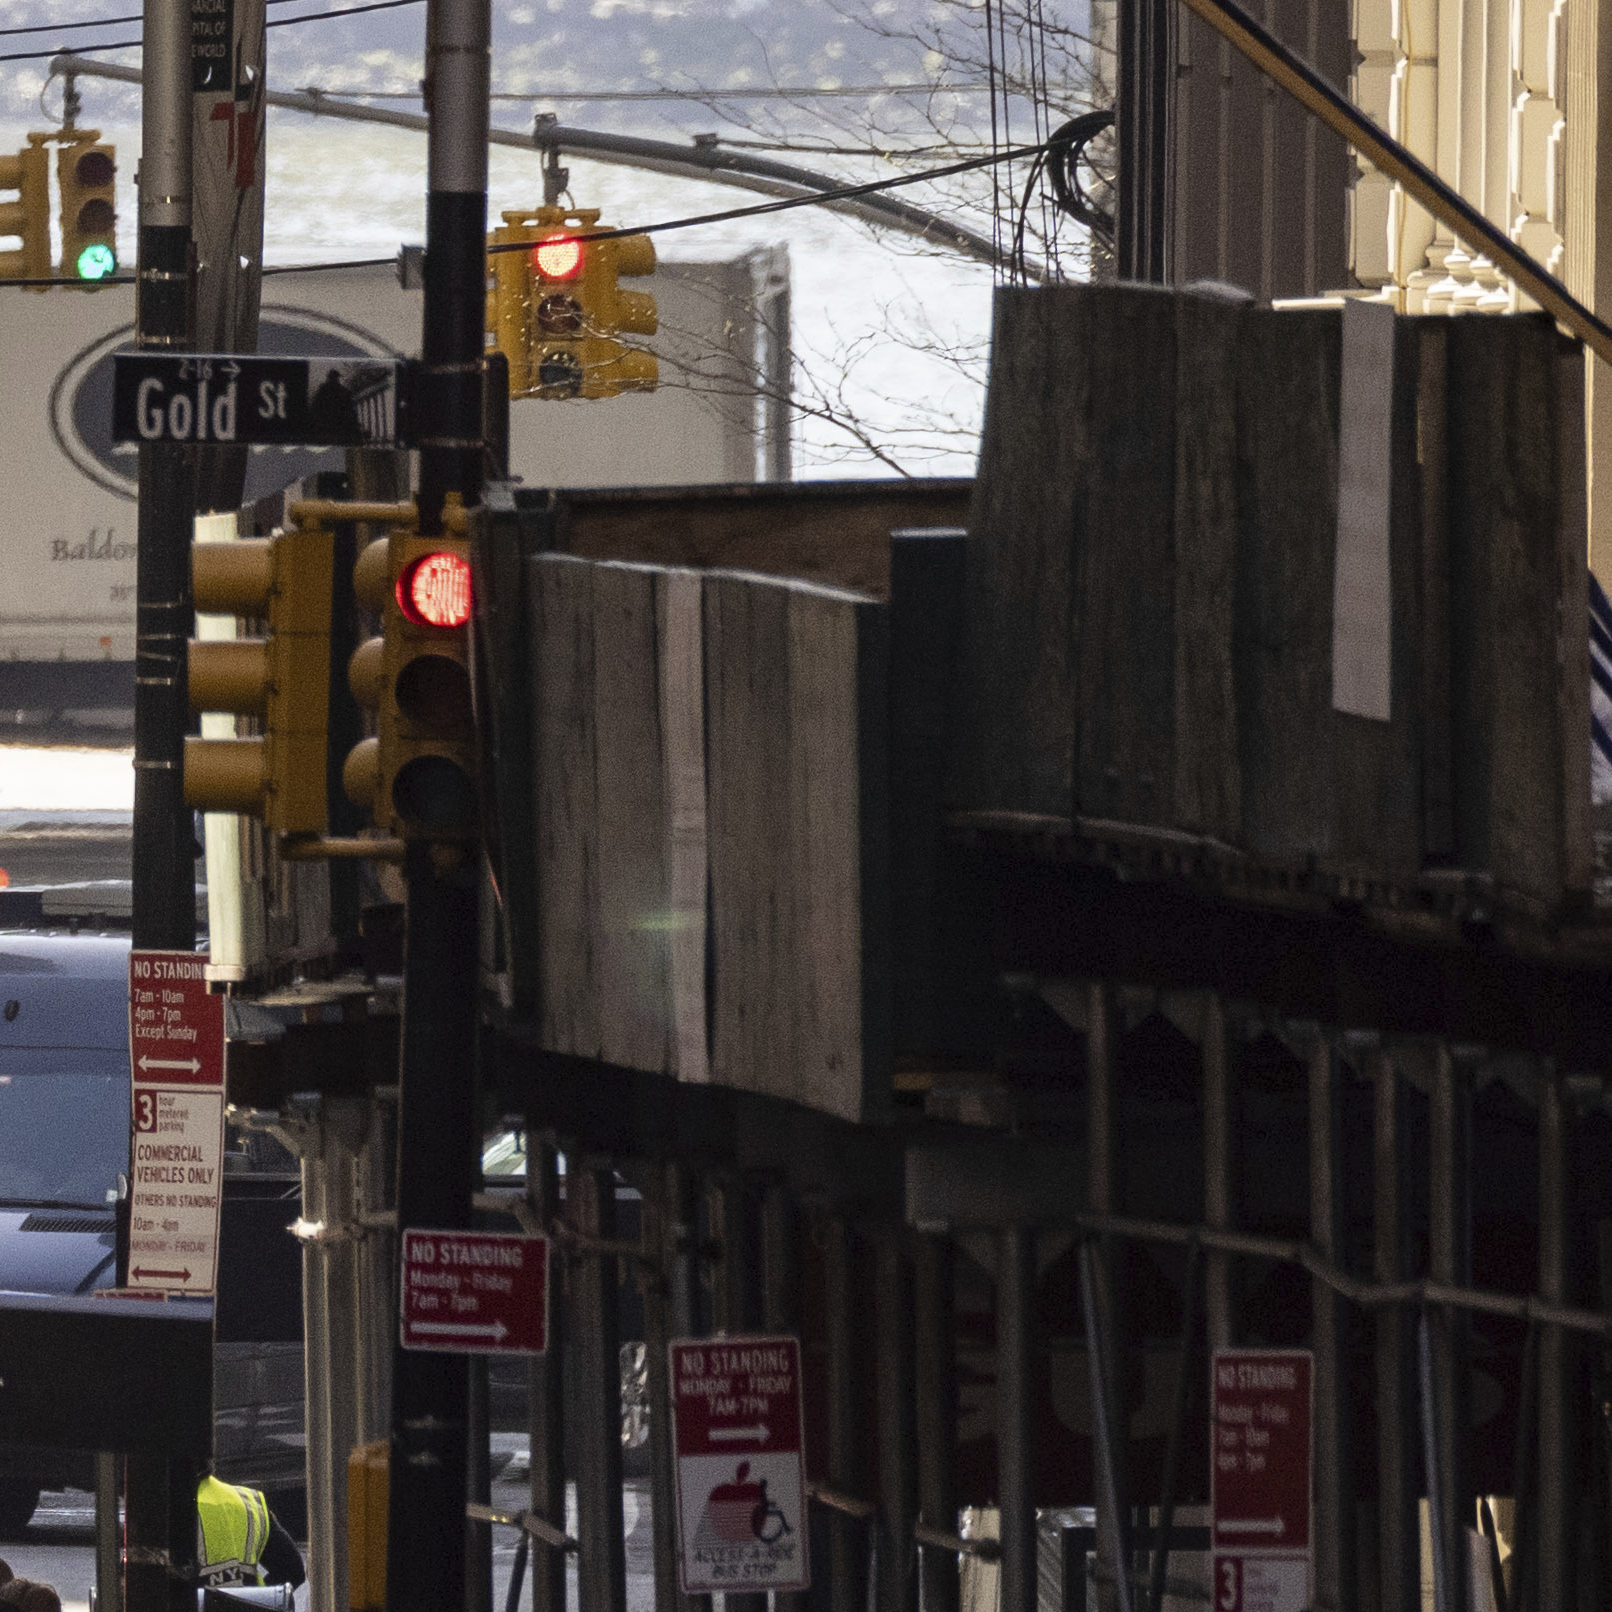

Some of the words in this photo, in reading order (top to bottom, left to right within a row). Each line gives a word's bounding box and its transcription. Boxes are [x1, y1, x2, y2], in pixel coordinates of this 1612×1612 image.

[136, 377, 237, 441] Gold
[258, 380, 287, 420] St
[133, 960, 151, 979] NO
[153, 961, 204, 980] STANDIN
[134, 988, 154, 1003] 7am
[161, 989, 185, 1004] 10am
[134, 1006, 155, 1022] 4pm
[162, 1006, 182, 1024] 7pm
[135, 1024, 165, 1040] Except
[166, 1025, 198, 1044] Sunday
[138, 1094, 154, 1131] 3
[158, 1108, 190, 1120] metered
[158, 1120, 185, 1133] parking
[137, 1144, 204, 1163] COMMERCIAL
[136, 1166, 185, 1184] VEHICLES
[187, 1167, 215, 1185] ONLY
[134, 1194, 165, 1207] OTHERS
[165, 1195, 177, 1207] NO
[178, 1195, 217, 1209] STANDING
[133, 1217, 154, 1232] 10am
[411, 1240, 436, 1263] NO
[439, 1243, 523, 1267] STANDING
[410, 1269, 460, 1293] Monday
[472, 1272, 514, 1293] Friday
[681, 1352, 705, 1375] NO
[710, 1349, 790, 1375] STANDING
[748, 1376, 792, 1395] FRIDAY
[1218, 1364, 1236, 1390] NO
[1219, 1561, 1238, 1611] 3
